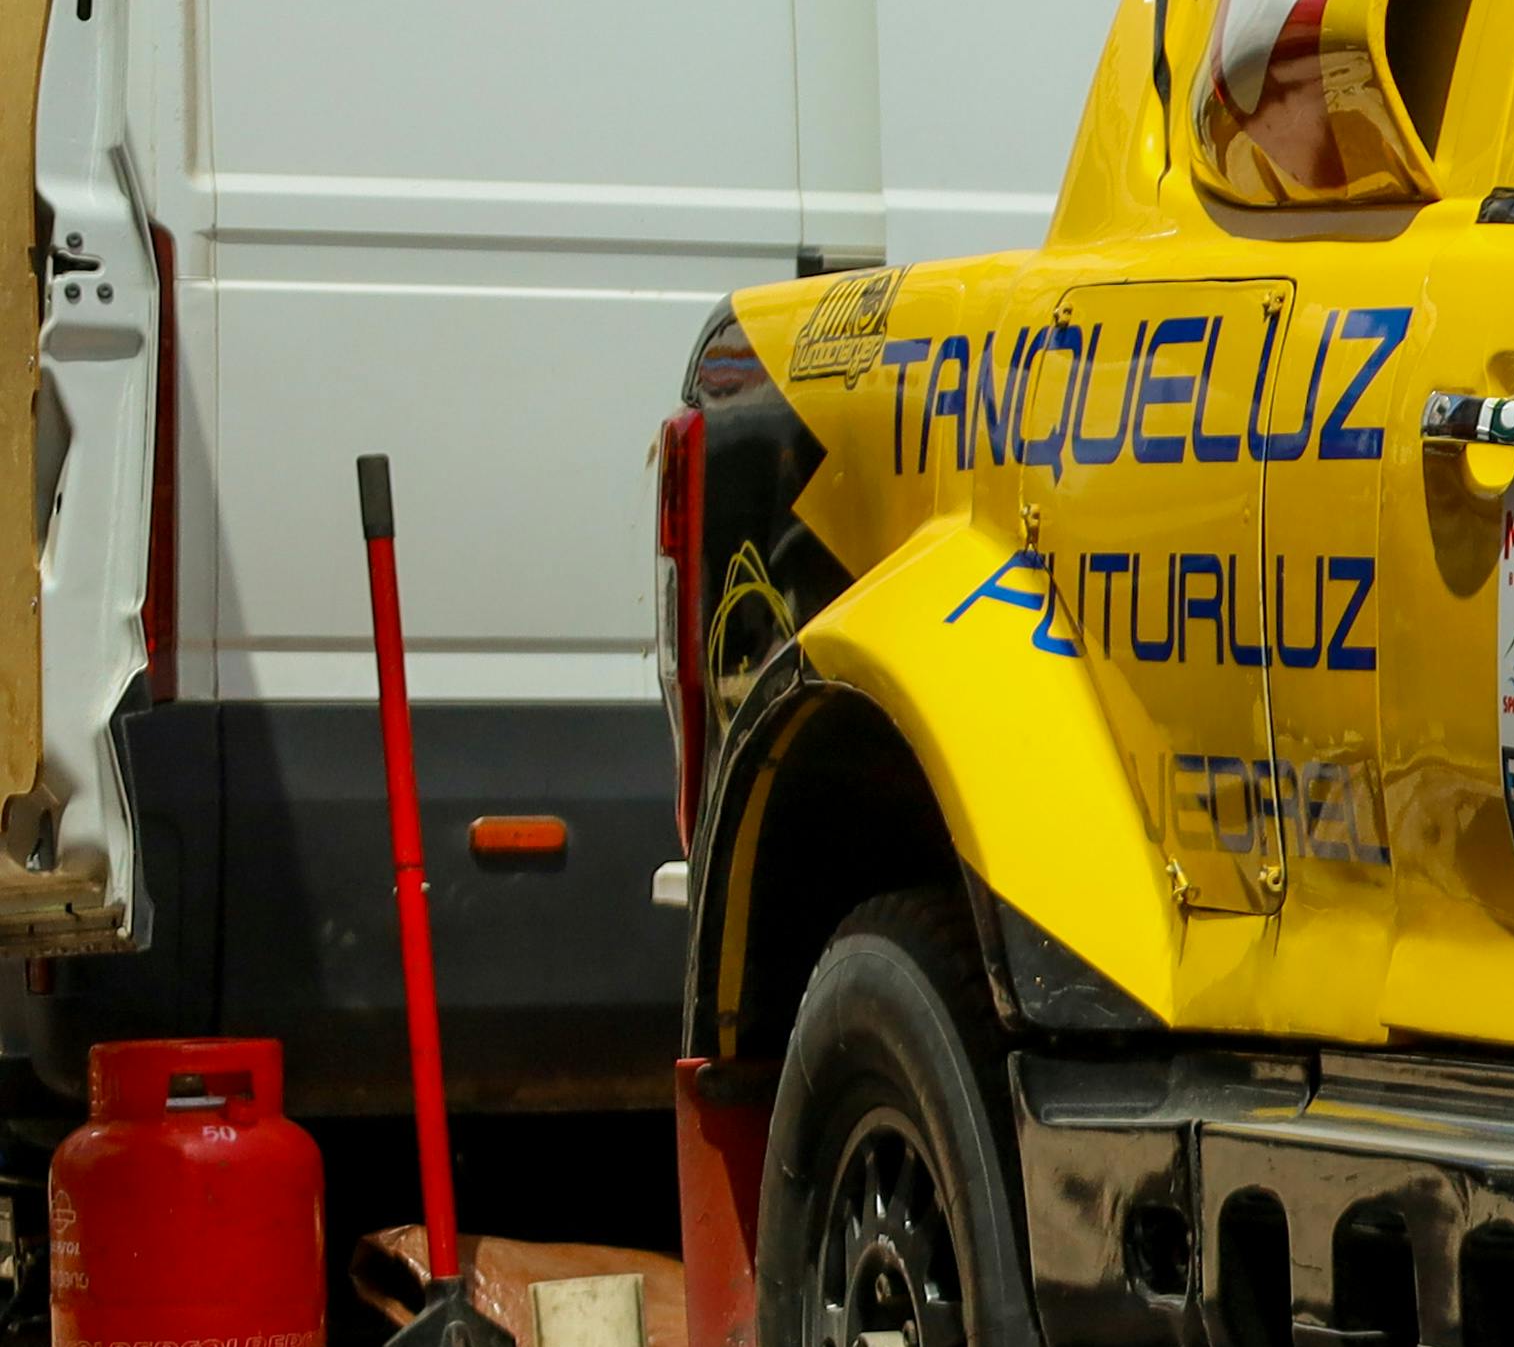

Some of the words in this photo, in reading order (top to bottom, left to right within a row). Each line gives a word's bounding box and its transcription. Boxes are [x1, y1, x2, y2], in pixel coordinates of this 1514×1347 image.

[882, 307, 1413, 485] TANQUELUZ
[945, 550, 1378, 672] FUTURLUZ
[202, 1126, 237, 1143] 50
